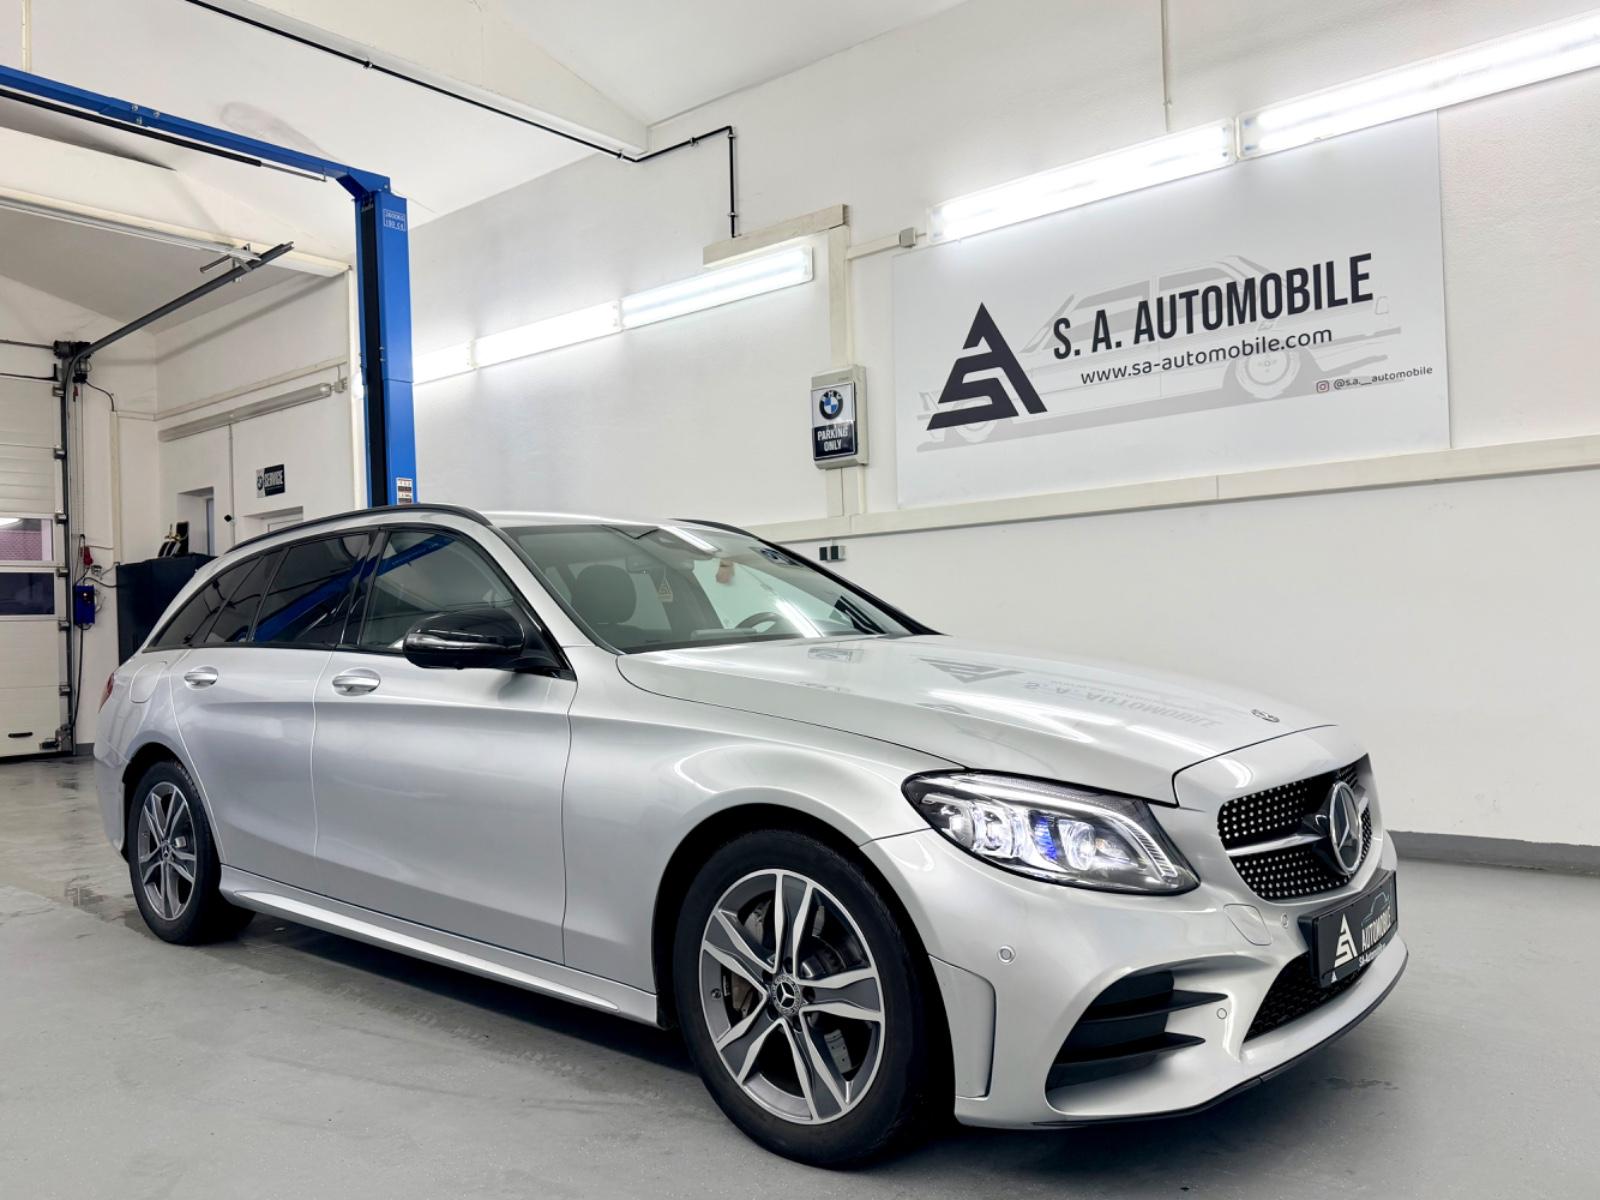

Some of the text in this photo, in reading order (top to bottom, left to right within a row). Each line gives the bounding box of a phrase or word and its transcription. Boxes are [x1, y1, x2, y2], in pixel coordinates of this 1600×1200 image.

[1053, 253, 1373, 359] S. A. AUTOMOBILE
[1080, 327, 1333, 385] www.sa-automobile.com
[817, 427, 849, 441] PARKING
[823, 439, 842, 452] ONLY
